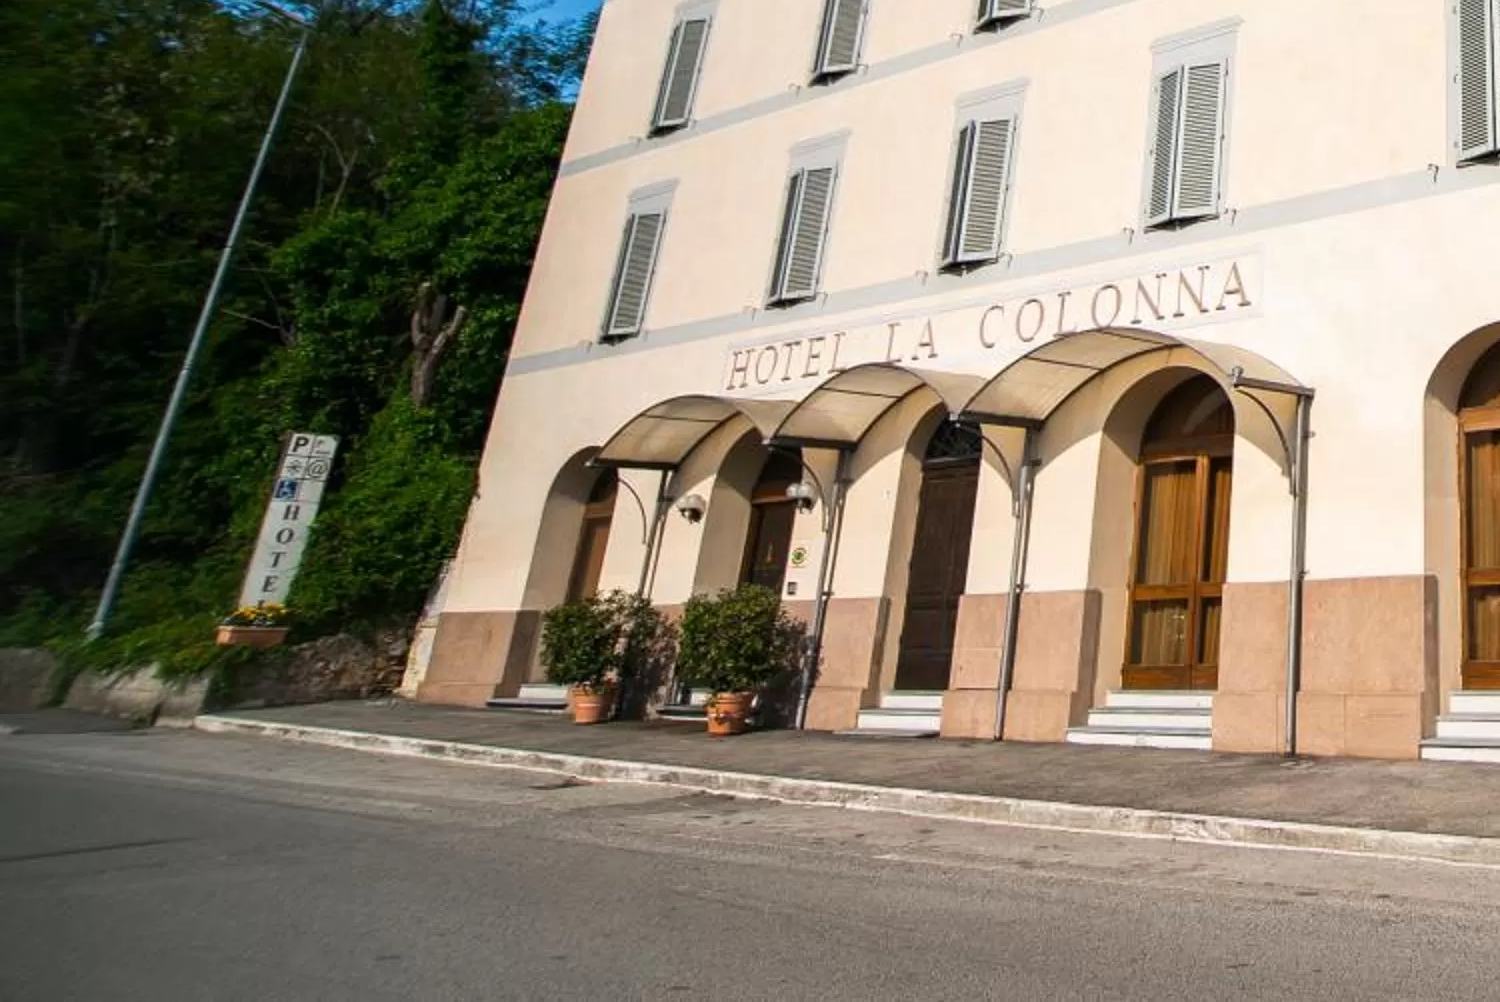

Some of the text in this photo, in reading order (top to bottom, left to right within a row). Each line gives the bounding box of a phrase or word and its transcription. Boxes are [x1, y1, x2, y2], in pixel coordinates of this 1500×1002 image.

[726, 261, 1252, 390] HOTEL LA COLONNA
[292, 436, 309, 452] P
